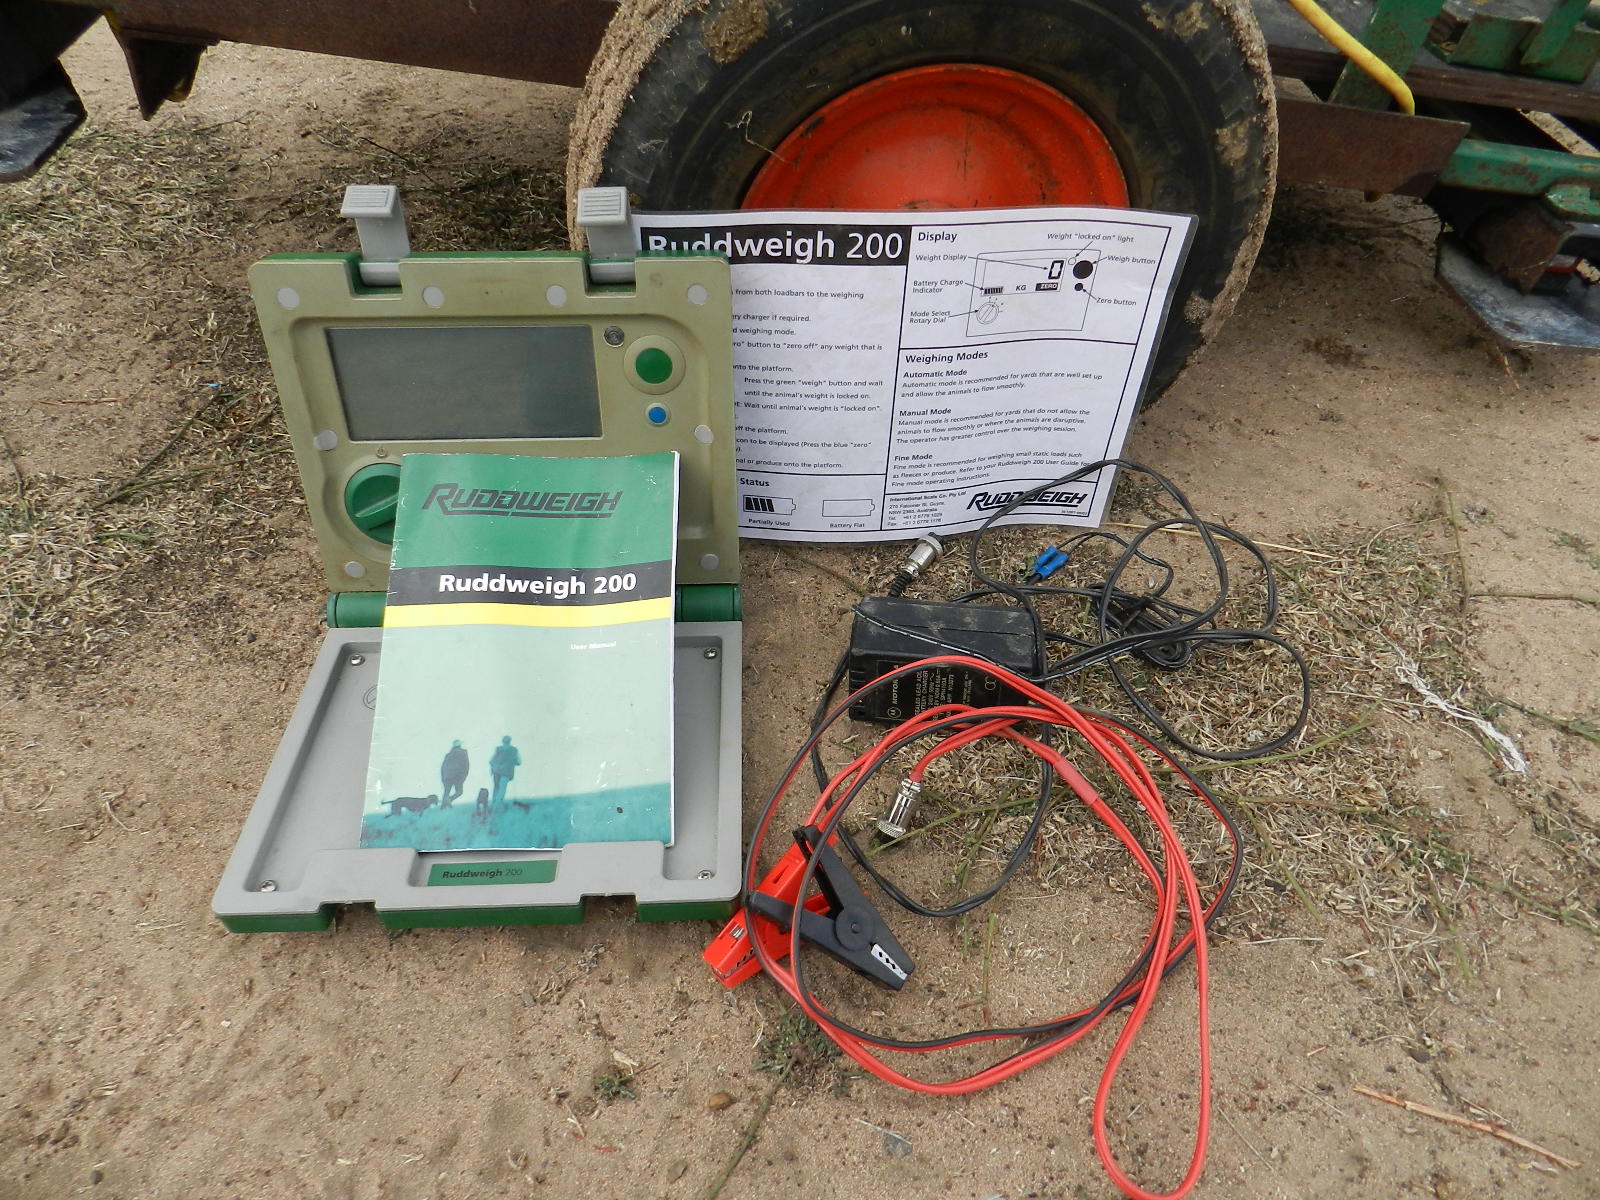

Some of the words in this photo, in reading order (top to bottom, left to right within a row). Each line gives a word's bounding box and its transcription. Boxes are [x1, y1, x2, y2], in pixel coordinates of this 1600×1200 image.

[918, 231, 957, 243] Display
[1047, 233, 1072, 241] Weight
[1118, 235, 1134, 243] light
[846, 232, 902, 259] 200
[915, 254, 941, 262] Weight
[943, 254, 967, 262] Display
[1107, 255, 1129, 263] Weigh
[1131, 257, 1156, 265] button
[1016, 284, 1027, 292] KG
[735, 288, 753, 296] from
[755, 288, 772, 296] both
[774, 289, 805, 297] loadbars
[830, 291, 864, 300] weighing
[1113, 298, 1137, 306] button
[743, 313, 770, 321] charger
[739, 327, 773, 335] weighing
[905, 353, 954, 365] Weighing
[956, 350, 989, 361] Modes
[761, 365, 794, 373] platform.
[945, 369, 968, 377] Mode
[964, 374, 1008, 384] recommended
[1020, 372, 1037, 380] yards
[774, 391, 803, 399] animal's
[804, 392, 829, 400] weight
[808, 404, 832, 412] weight
[899, 409, 928, 417] Manual
[950, 412, 994, 423] recommended
[757, 426, 788, 435] platform.
[768, 440, 800, 448] displayed
[755, 459, 783, 467] produce
[801, 460, 812, 468] the
[813, 461, 843, 469] platform.
[740, 477, 770, 487] Status
[421, 482, 623, 518] RUDDWEIGH
[966, 491, 1088, 511] RUDDEIGH
[749, 518, 774, 526] Partially
[438, 572, 586, 599] Ruddweigh
[593, 573, 637, 595] 200
[589, 640, 617, 650] Manual
[442, 869, 503, 879] Ruddweigh
[505, 868, 523, 877] 200
